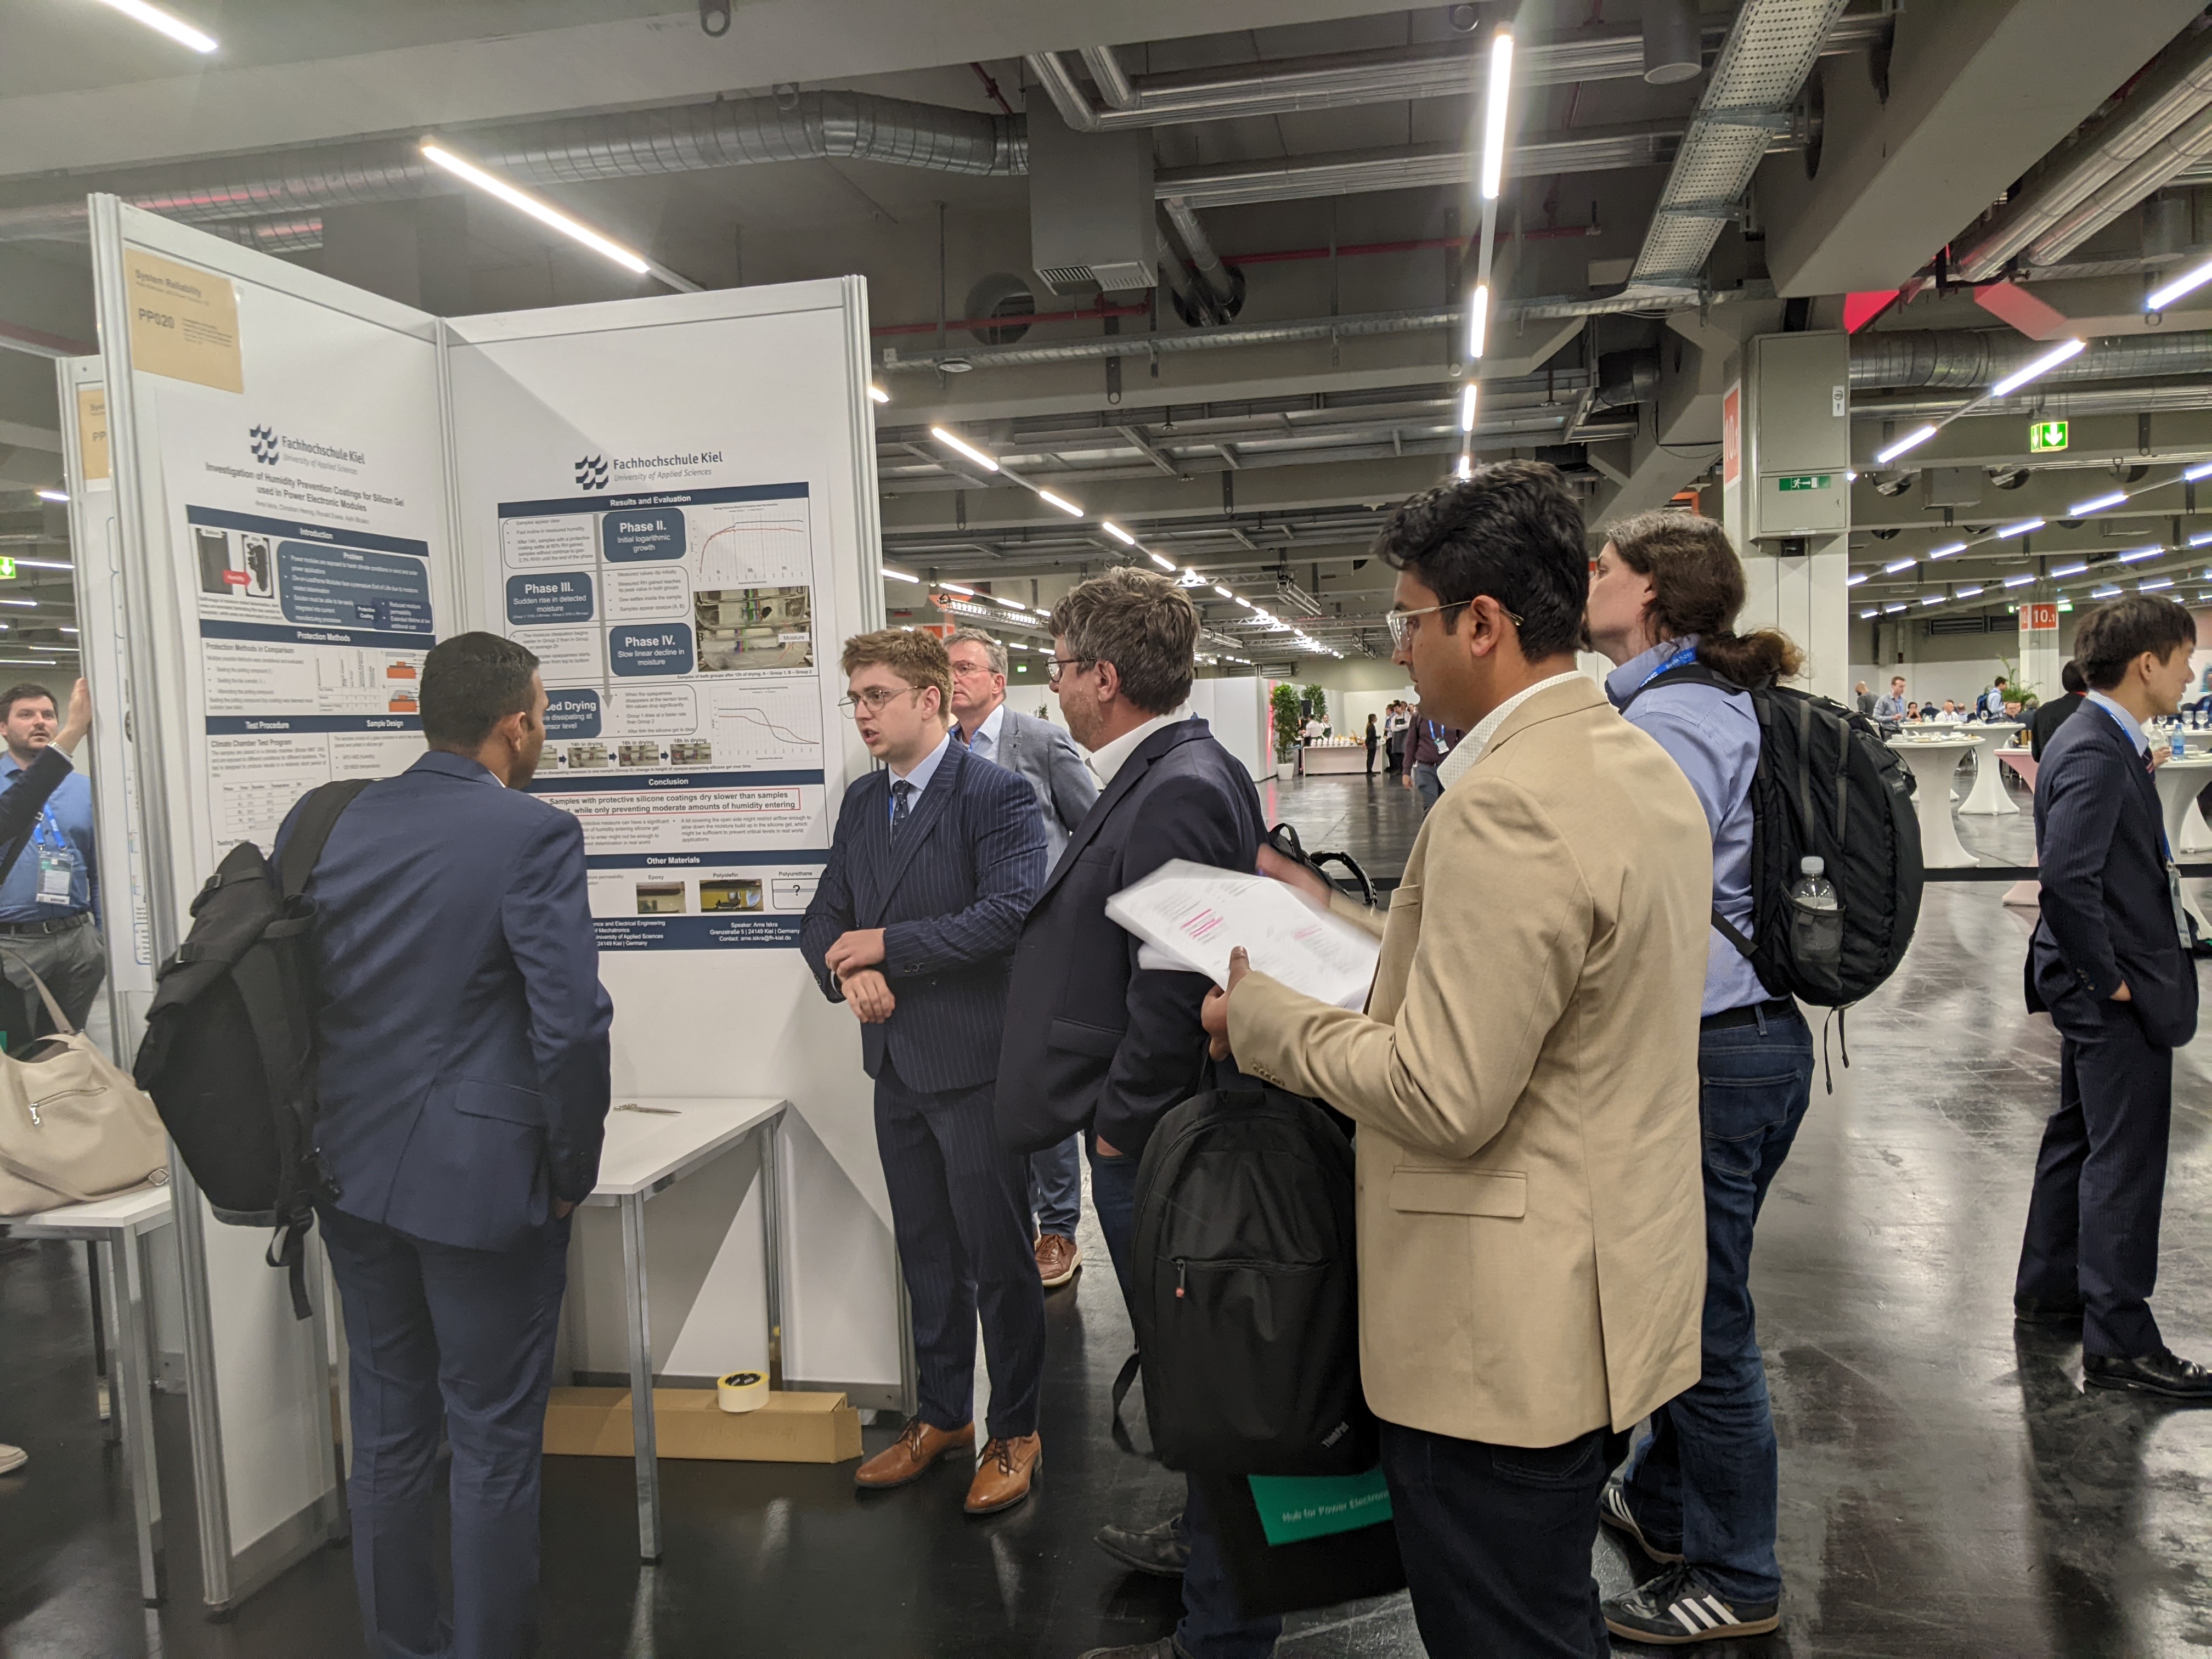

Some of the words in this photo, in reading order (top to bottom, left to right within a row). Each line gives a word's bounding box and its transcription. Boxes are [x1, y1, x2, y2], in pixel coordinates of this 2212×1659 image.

[139, 308, 174, 329] PP020
[281, 436, 347, 460] Fachhochschule
[349, 450, 365, 464] Kiel
[613, 453, 699, 470] Fachhochschule
[700, 451, 723, 463] Kiel
[614, 473, 646, 481] University
[648, 471, 655, 480] of
[657, 470, 682, 479] Applied
[206, 462, 253, 478] Investigation
[256, 472, 263, 480] of
[264, 473, 295, 488] Humidity
[296, 479, 332, 493] Prevention
[334, 486, 362, 500] Coatings
[362, 492, 371, 500] for
[373, 493, 393, 504] Silicon
[394, 498, 404, 506] Gel
[257, 487, 274, 495] used
[283, 490, 304, 500] Power
[307, 494, 338, 506] Electronic
[340, 499, 366, 511] Modules
[653, 495, 691, 503] Evaluation
[619, 522, 654, 533] Phase
[656, 520, 667, 531] II.
[300, 527, 334, 540] Introduction
[635, 534, 670, 543] logarithmic
[633, 544, 655, 553] growth
[524, 584, 558, 594] Phase
[561, 582, 574, 592] III.
[2034, 609, 2055, 623] 10.1
[297, 631, 326, 640] Protection
[327, 633, 351, 642] Methods
[625, 636, 659, 647] Phase
[662, 634, 676, 646] IV.
[565, 701, 596, 712] Drying
[366, 720, 386, 728] Sample
[549, 798, 579, 807] Samples
[598, 796, 634, 804] protective
[594, 806, 610, 815] only
[611, 805, 650, 815] preventing
[652, 804, 686, 814] moderate
[688, 803, 720, 812] amounts
[722, 803, 729, 812] of
[731, 802, 763, 811] humidity
[764, 801, 795, 810] entering
[793, 884, 800, 896] ?
[1282, 1510, 1302, 1523] Hub
[1303, 1508, 1316, 1518] for
[1318, 1502, 1347, 1516] Power
